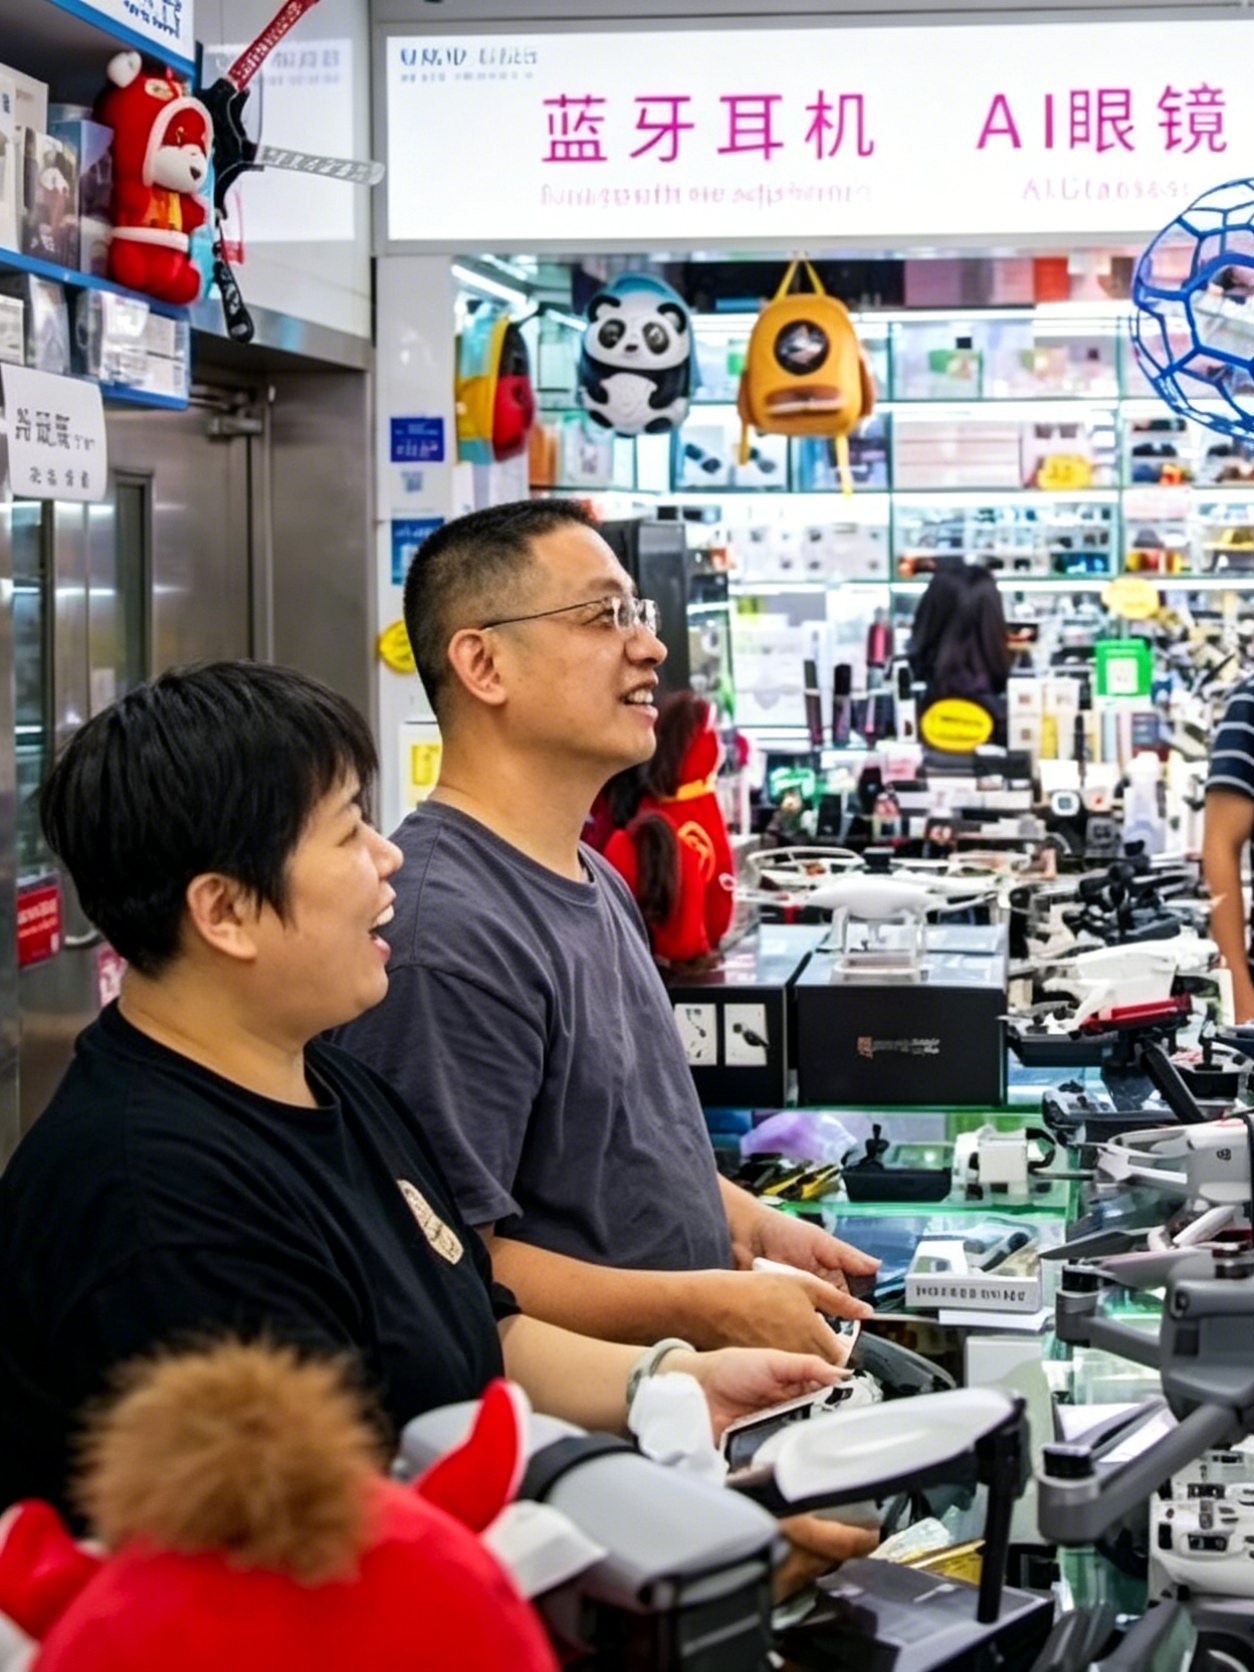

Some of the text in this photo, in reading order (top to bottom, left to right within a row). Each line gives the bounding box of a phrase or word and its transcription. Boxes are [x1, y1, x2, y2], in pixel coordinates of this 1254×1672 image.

[541, 83, 1227, 163] 蓝牙耳机 AI眼镜
